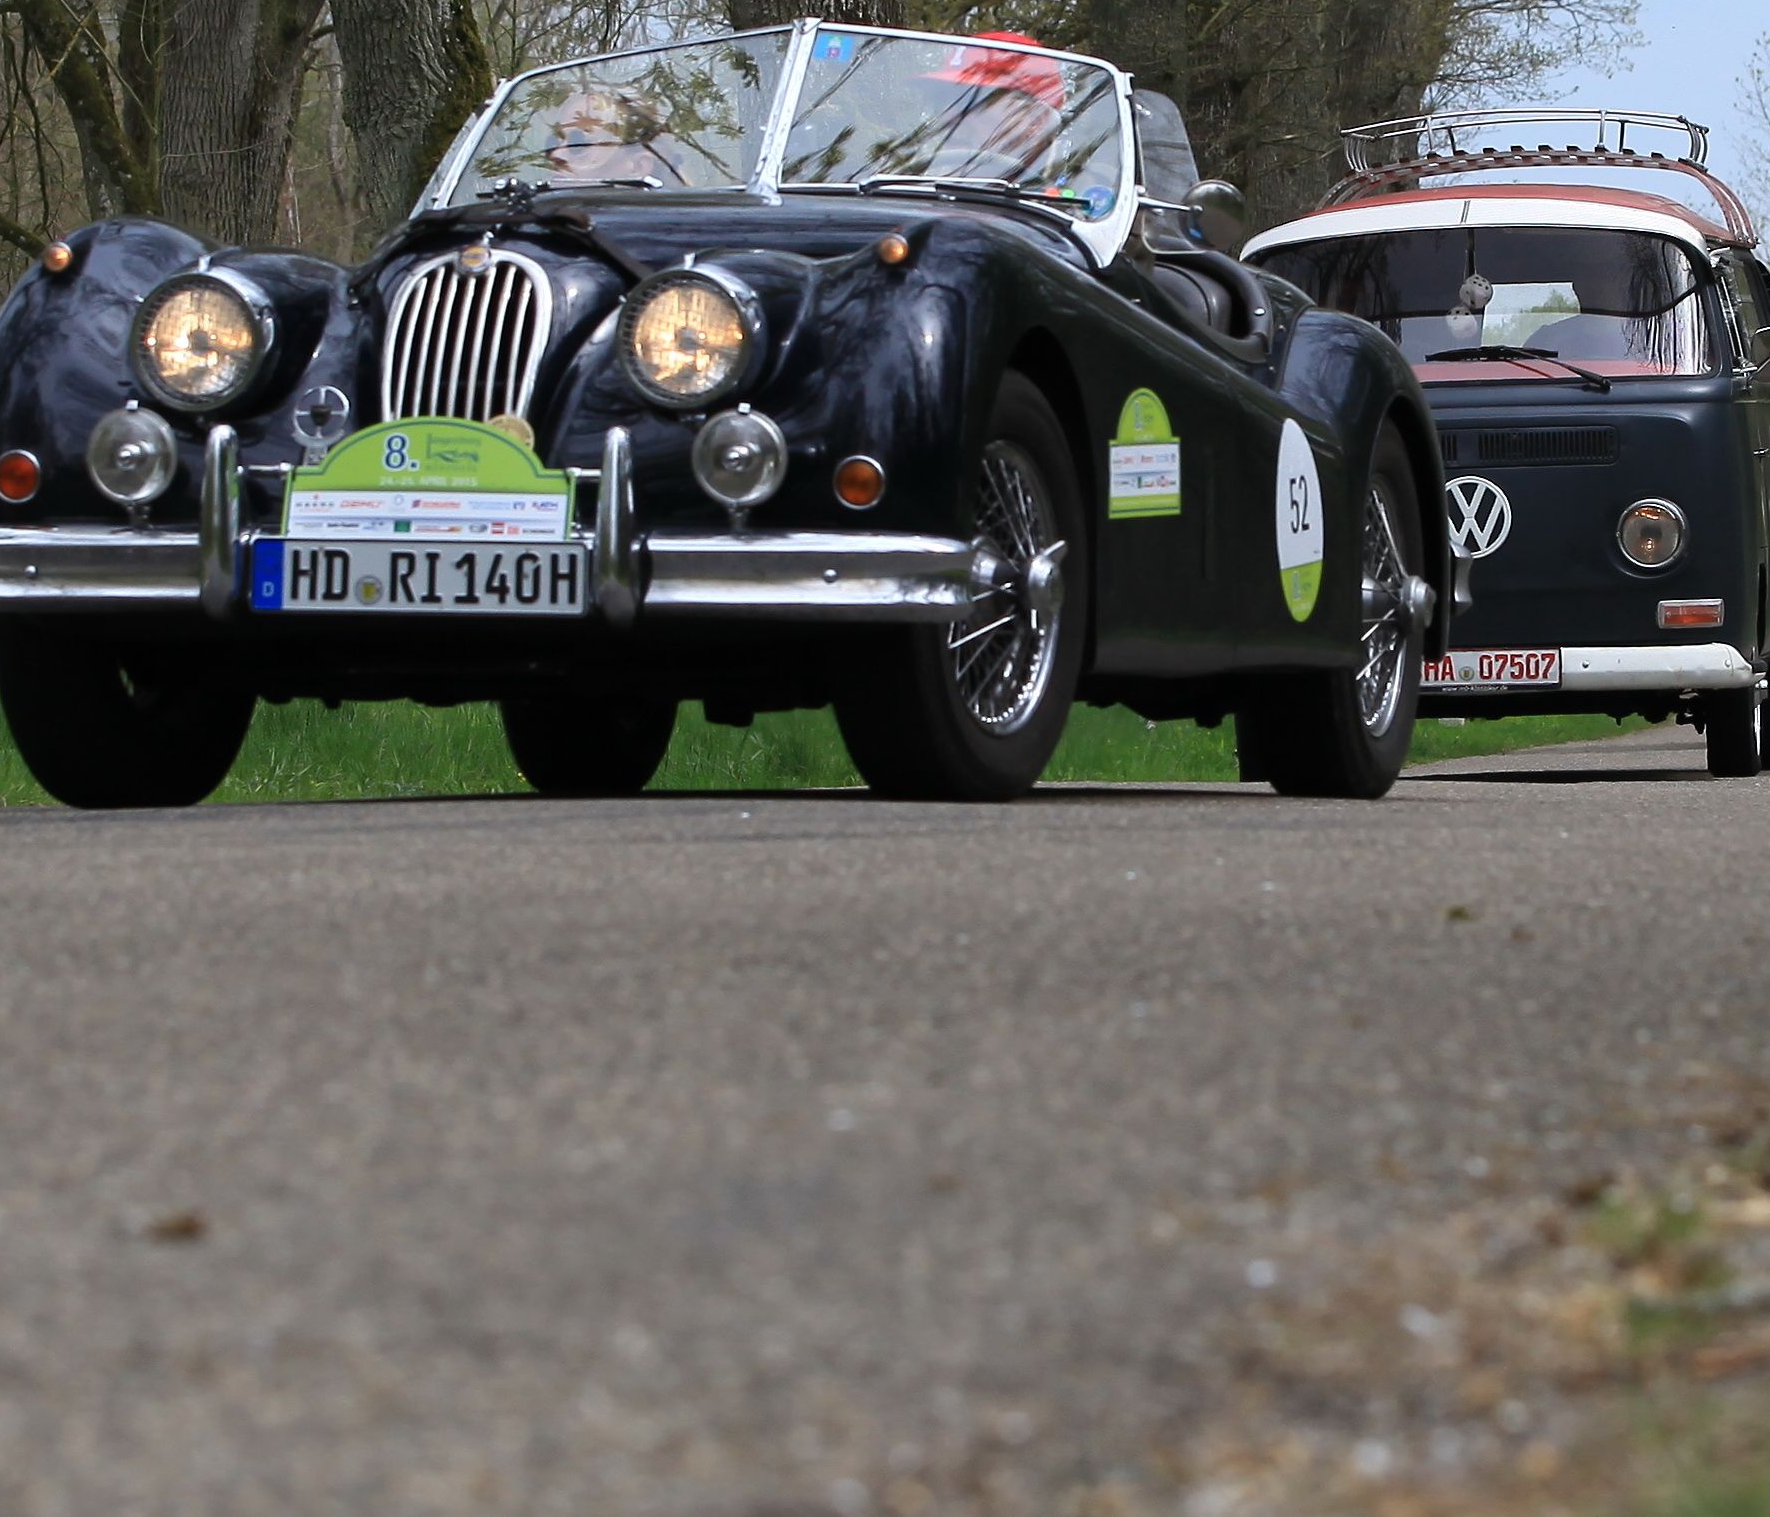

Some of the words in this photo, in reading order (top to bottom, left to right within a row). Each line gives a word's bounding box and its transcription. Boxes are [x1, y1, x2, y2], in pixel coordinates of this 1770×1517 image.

[383, 434, 419, 470] 8.
[1289, 475, 1310, 534] 52
[262, 581, 275, 598] D
[290, 549, 350, 601] HD
[1422, 655, 1456, 682] HA
[1479, 653, 1557, 680] 07507
